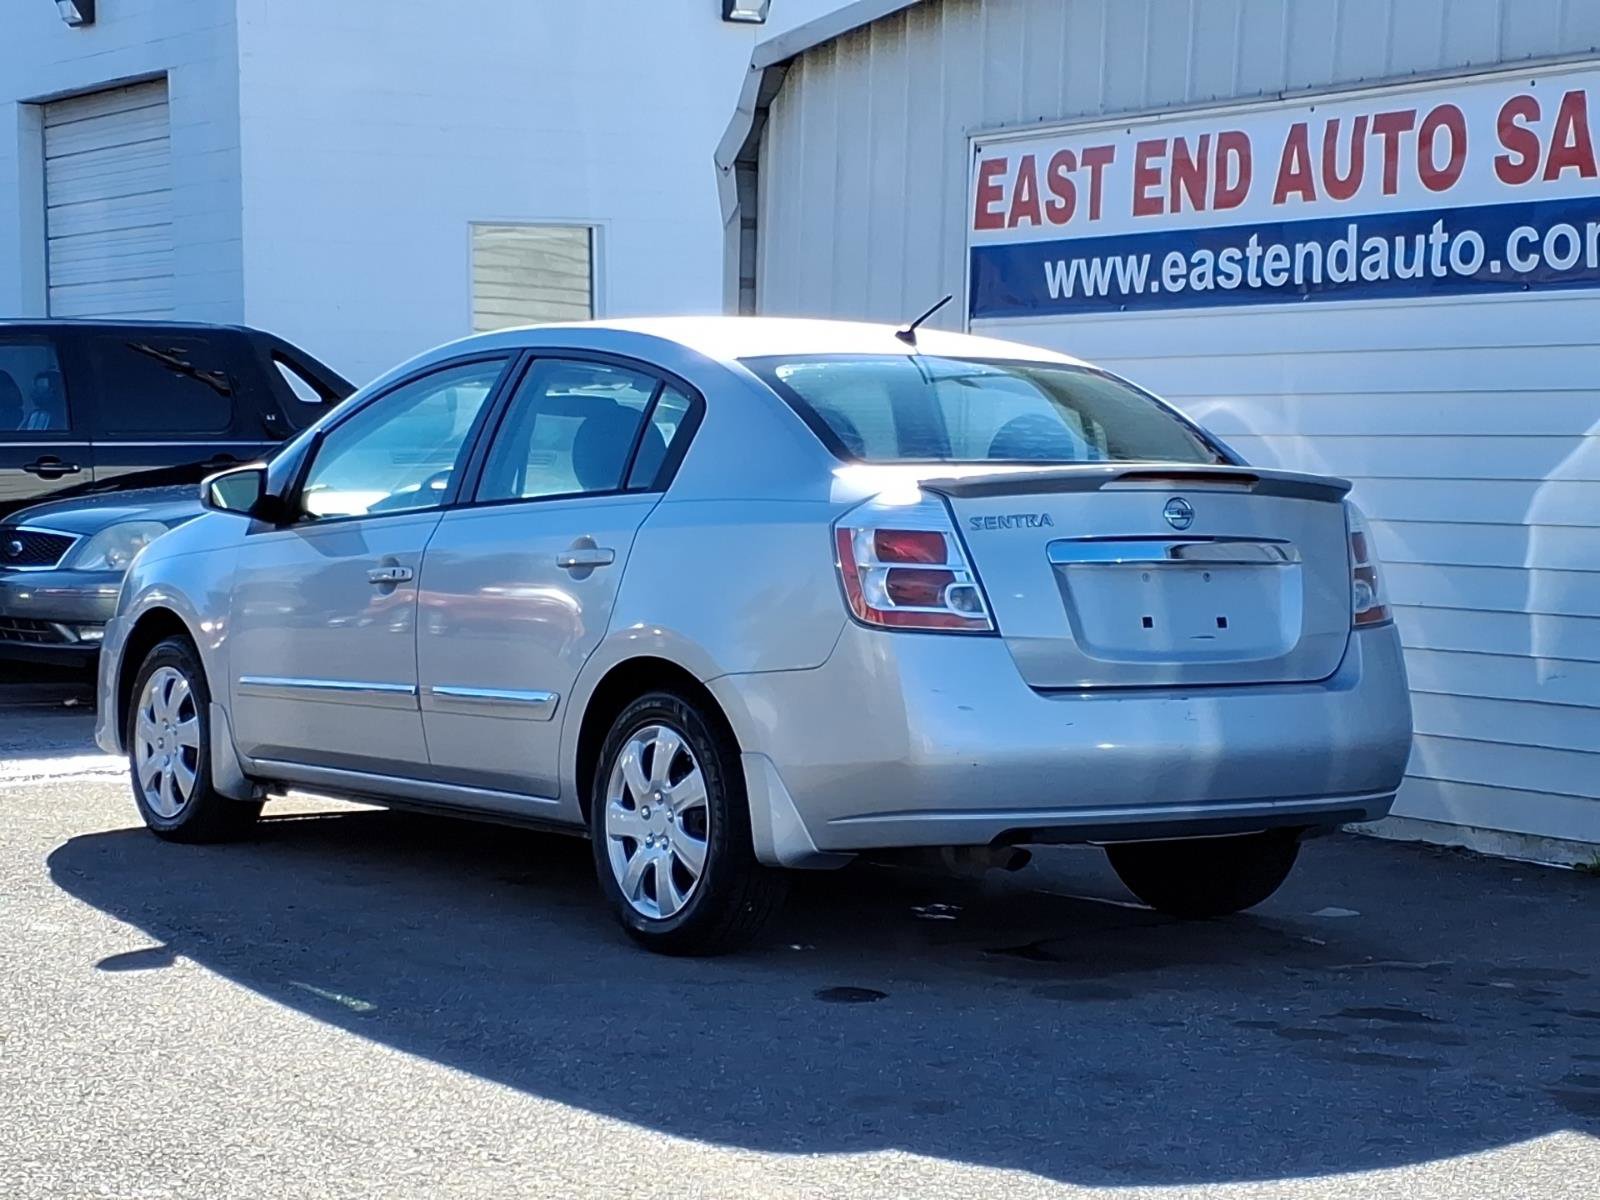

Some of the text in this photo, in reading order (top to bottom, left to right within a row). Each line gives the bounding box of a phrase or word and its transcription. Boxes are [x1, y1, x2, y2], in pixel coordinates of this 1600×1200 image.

[974, 89, 1598, 230] EAST END AUTO SA
[970, 513, 1054, 530] SENTRA
